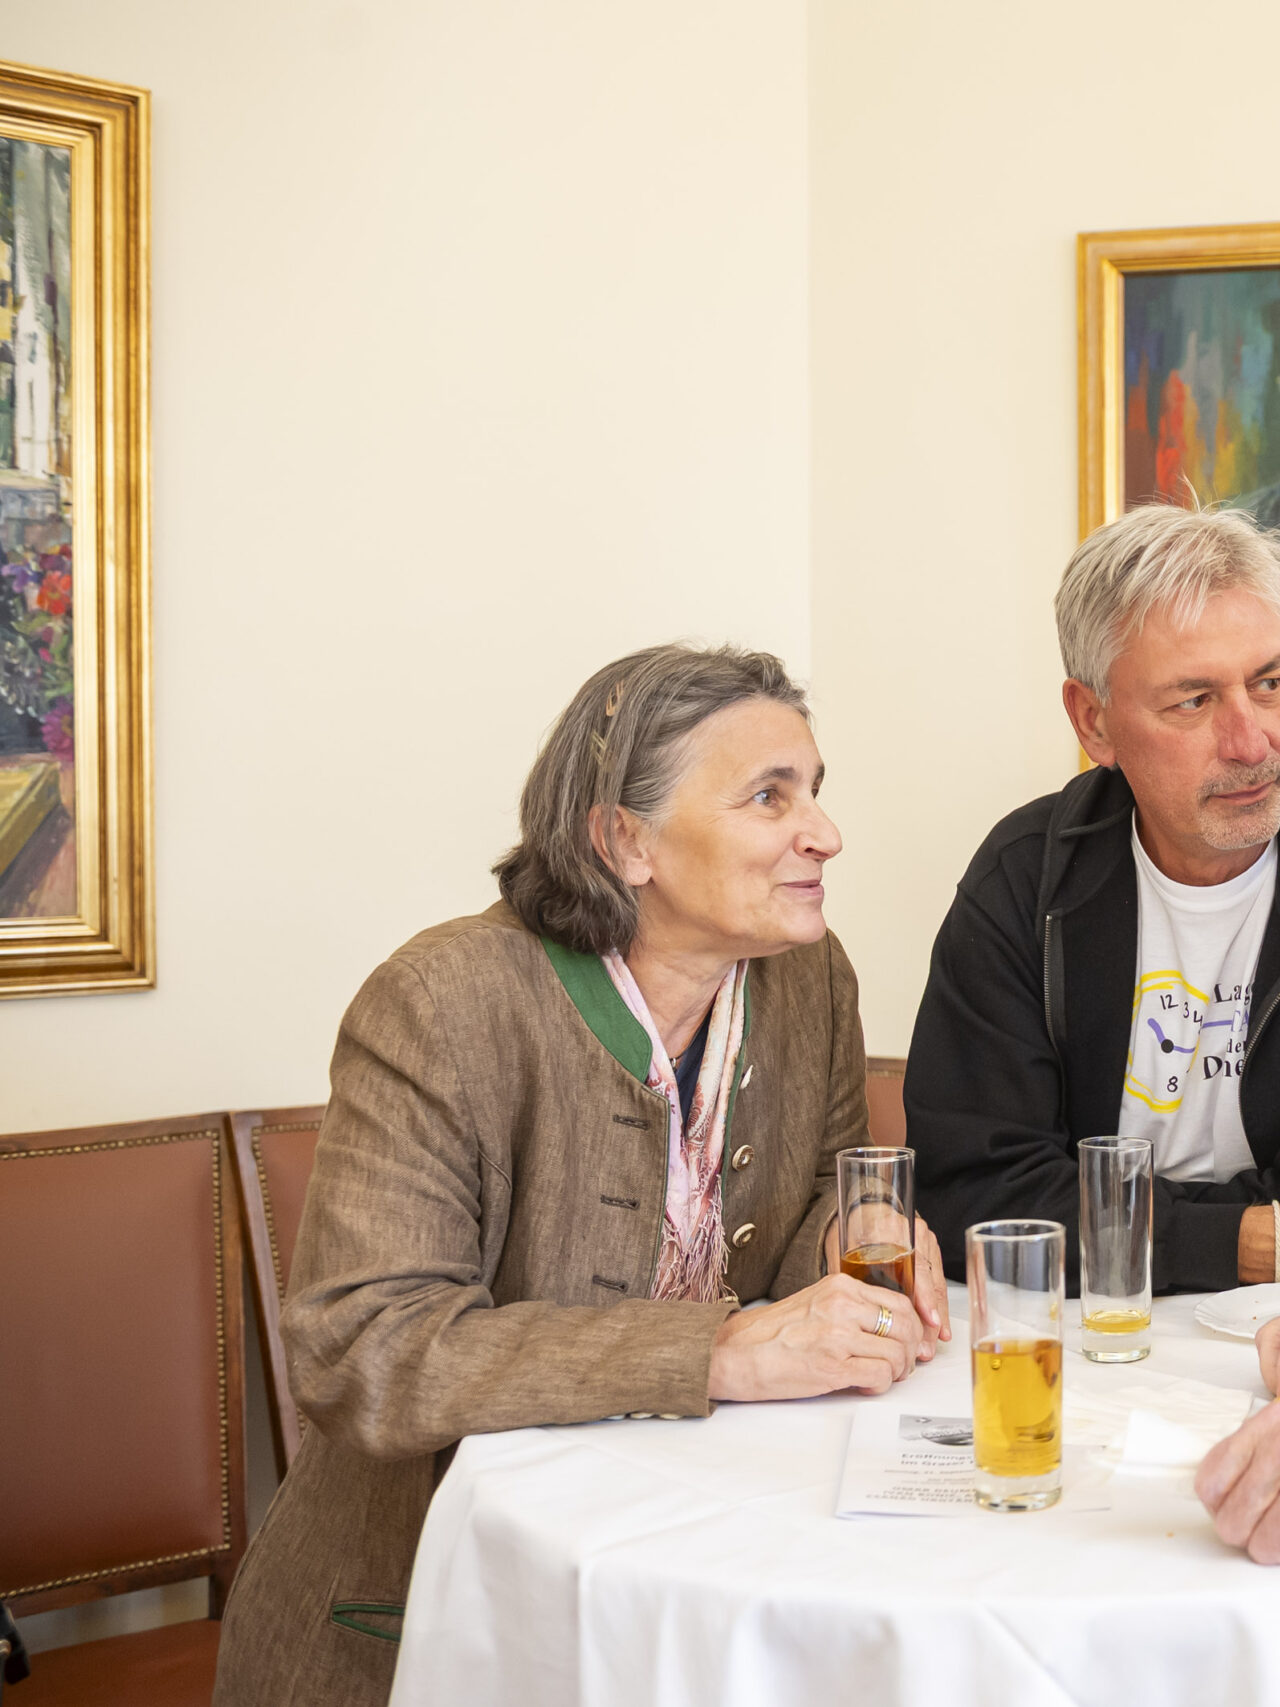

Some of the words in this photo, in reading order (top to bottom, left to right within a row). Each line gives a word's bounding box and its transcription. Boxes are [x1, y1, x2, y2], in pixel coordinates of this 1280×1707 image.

[1160, 994, 1178, 1010] 12
[1183, 1002, 1190, 1018] 3
[1193, 1010, 1203, 1027] 4
[1167, 1076, 1178, 1092] 8
